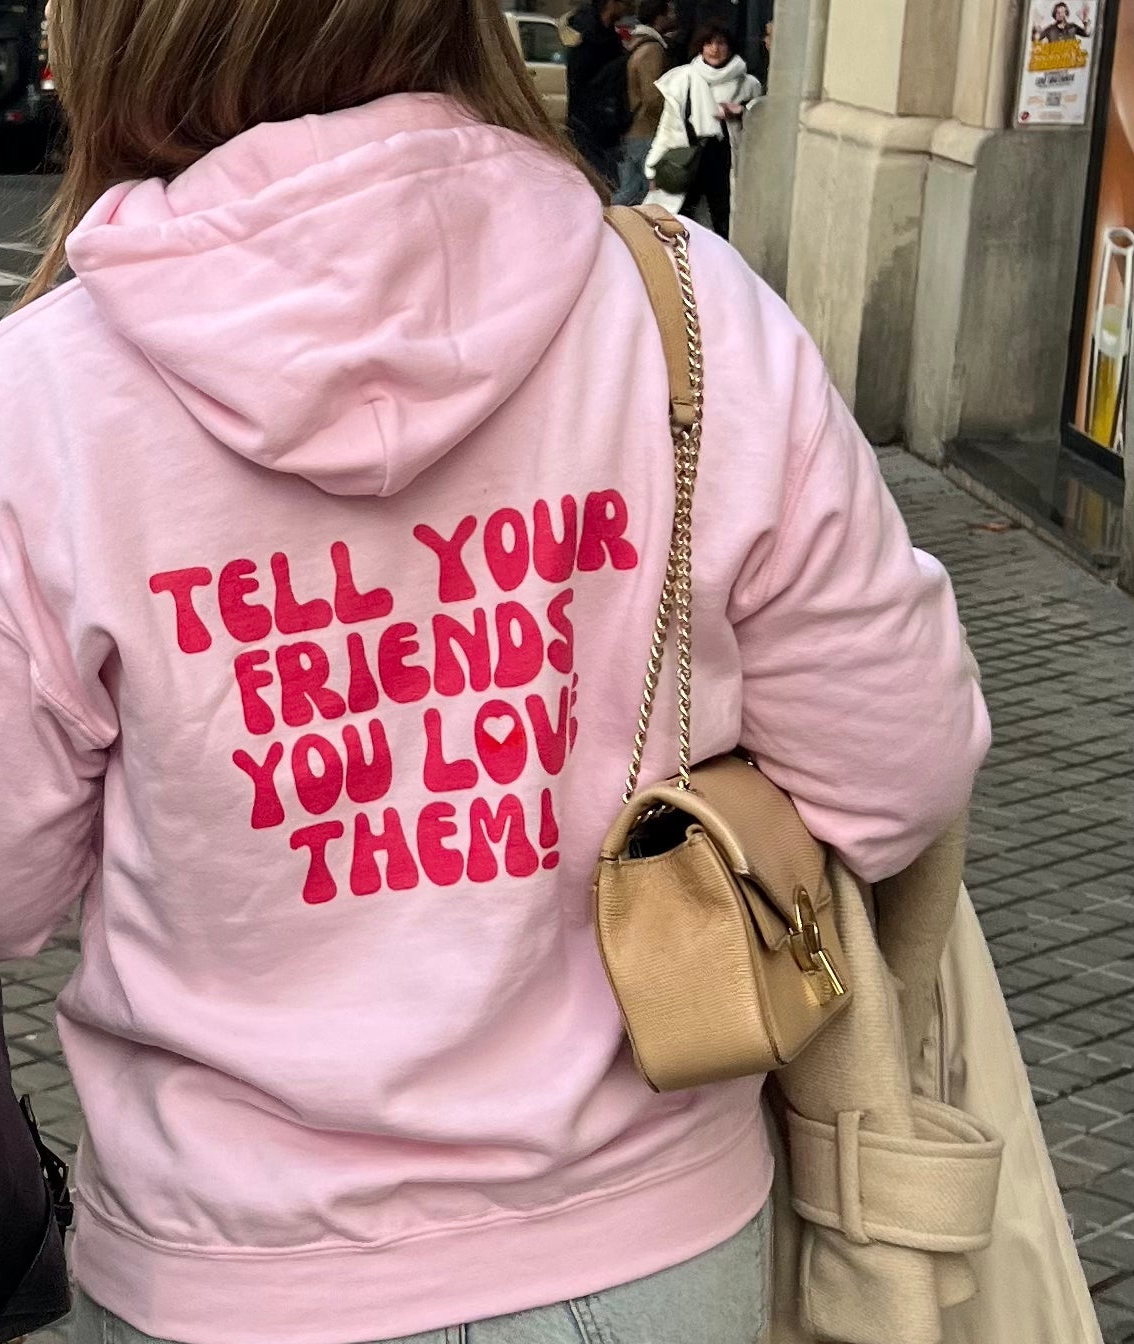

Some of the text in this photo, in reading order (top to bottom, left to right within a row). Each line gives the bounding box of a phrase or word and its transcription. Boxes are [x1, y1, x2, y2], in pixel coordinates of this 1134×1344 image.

[149, 489, 639, 655] TELL YOUR
[233, 587, 574, 735] FRIENDS
[232, 718, 392, 830] YOU
[290, 788, 560, 905] THEM!
